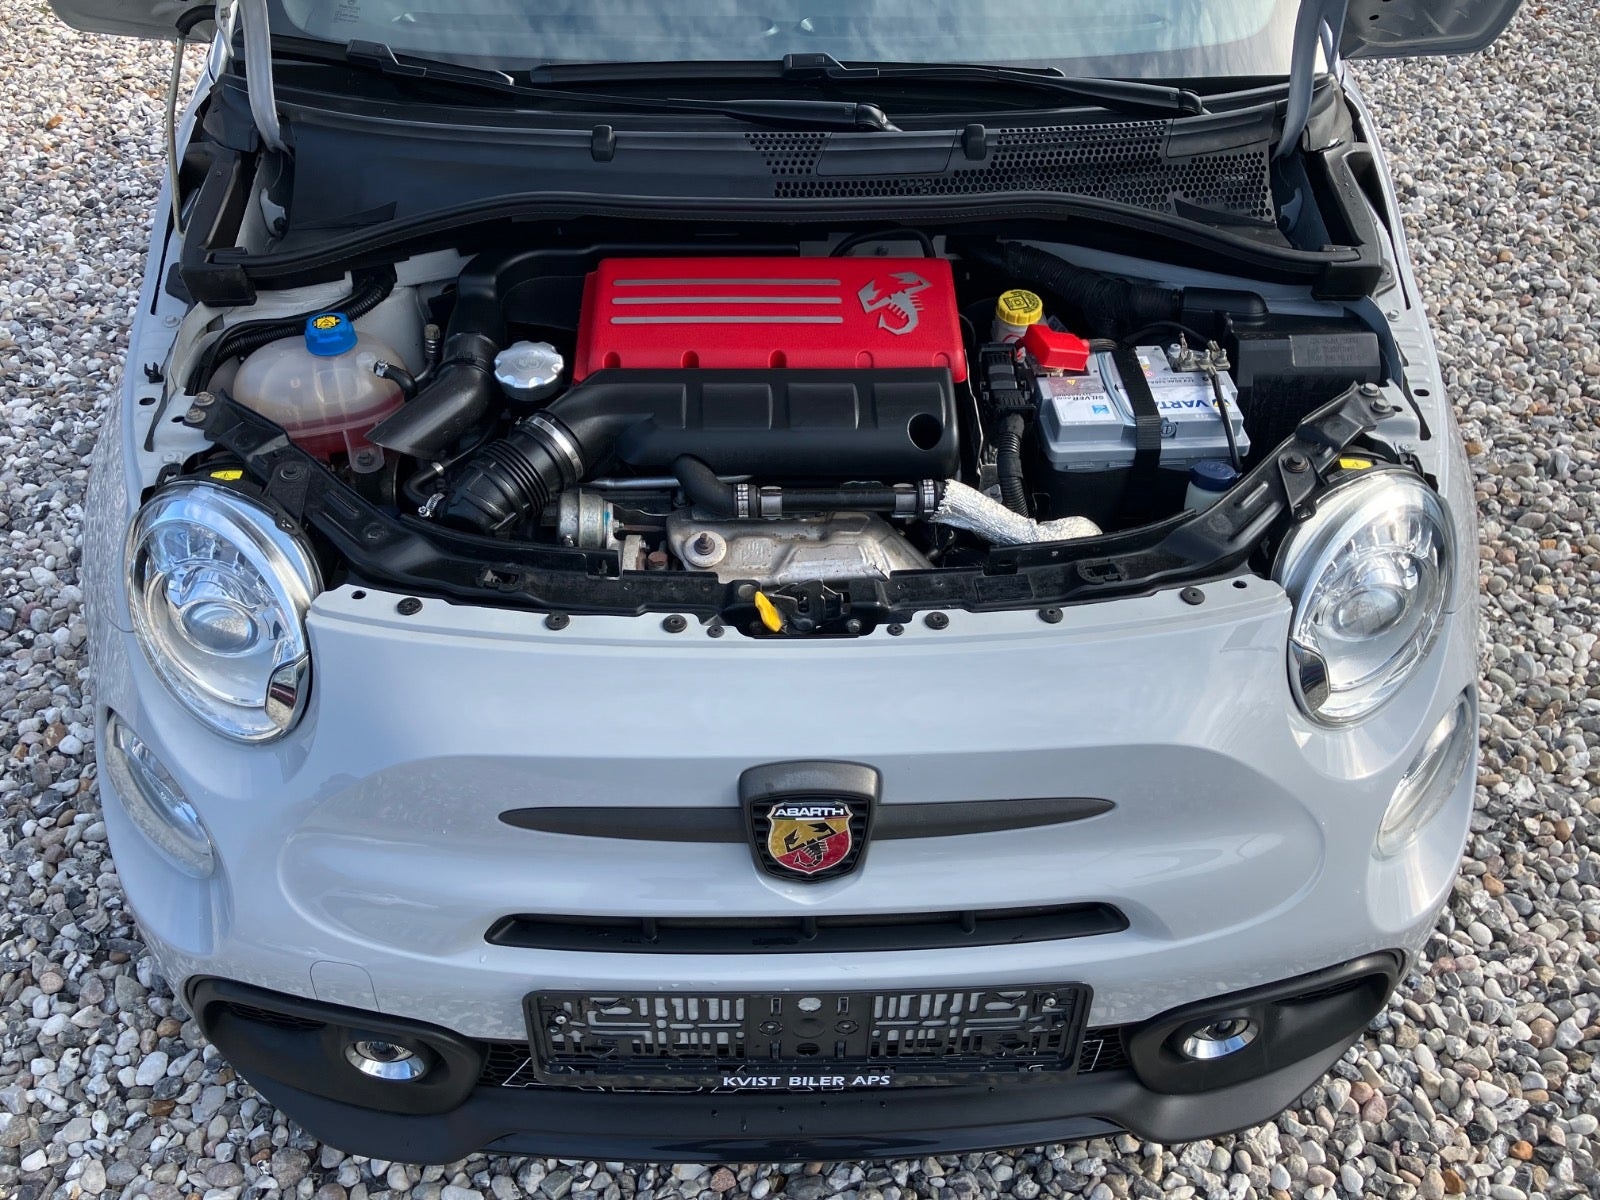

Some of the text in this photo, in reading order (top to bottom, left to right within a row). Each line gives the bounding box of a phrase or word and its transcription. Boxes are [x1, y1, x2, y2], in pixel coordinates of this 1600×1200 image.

[775, 807, 844, 816] ABARTH
[722, 1075, 891, 1086] KVIST BILER APS
